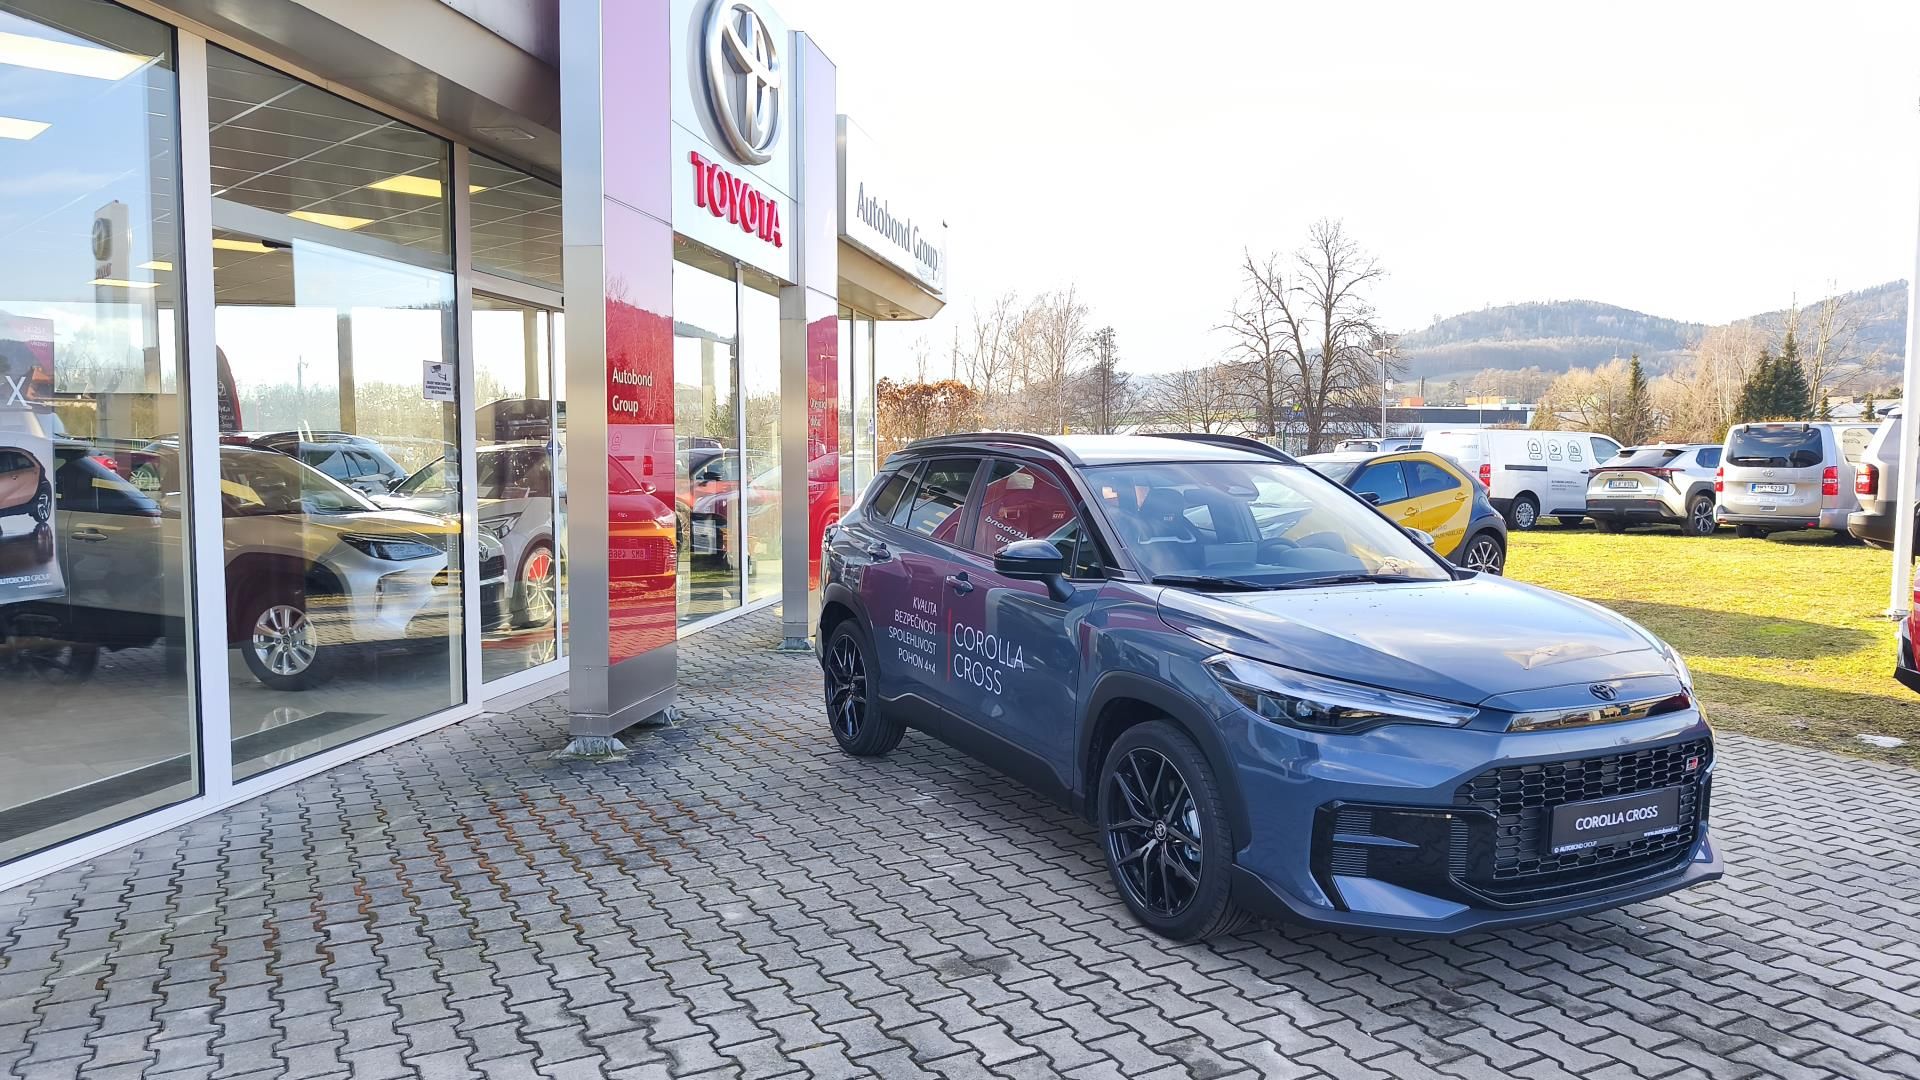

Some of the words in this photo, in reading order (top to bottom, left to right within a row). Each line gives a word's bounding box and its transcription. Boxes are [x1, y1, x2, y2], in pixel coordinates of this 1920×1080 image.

[688, 150, 782, 248] TOYOTA
[856, 181, 910, 253] Autobond
[912, 225, 938, 280] Group
[612, 366, 653, 387] Autobond
[5, 375, 28, 407] X
[612, 394, 639, 417] Group
[912, 596, 938, 616] KVALITA
[894, 609, 937, 635] BEZPEČNOST
[888, 626, 937, 655] SPOLEHLIVOST
[954, 622, 1025, 672] COROLLA
[898, 647, 924, 669] POHON
[953, 653, 1002, 695] CROSS
[1575, 812, 1625, 831] COROLLA
[1625, 805, 1659, 822] CROSS
